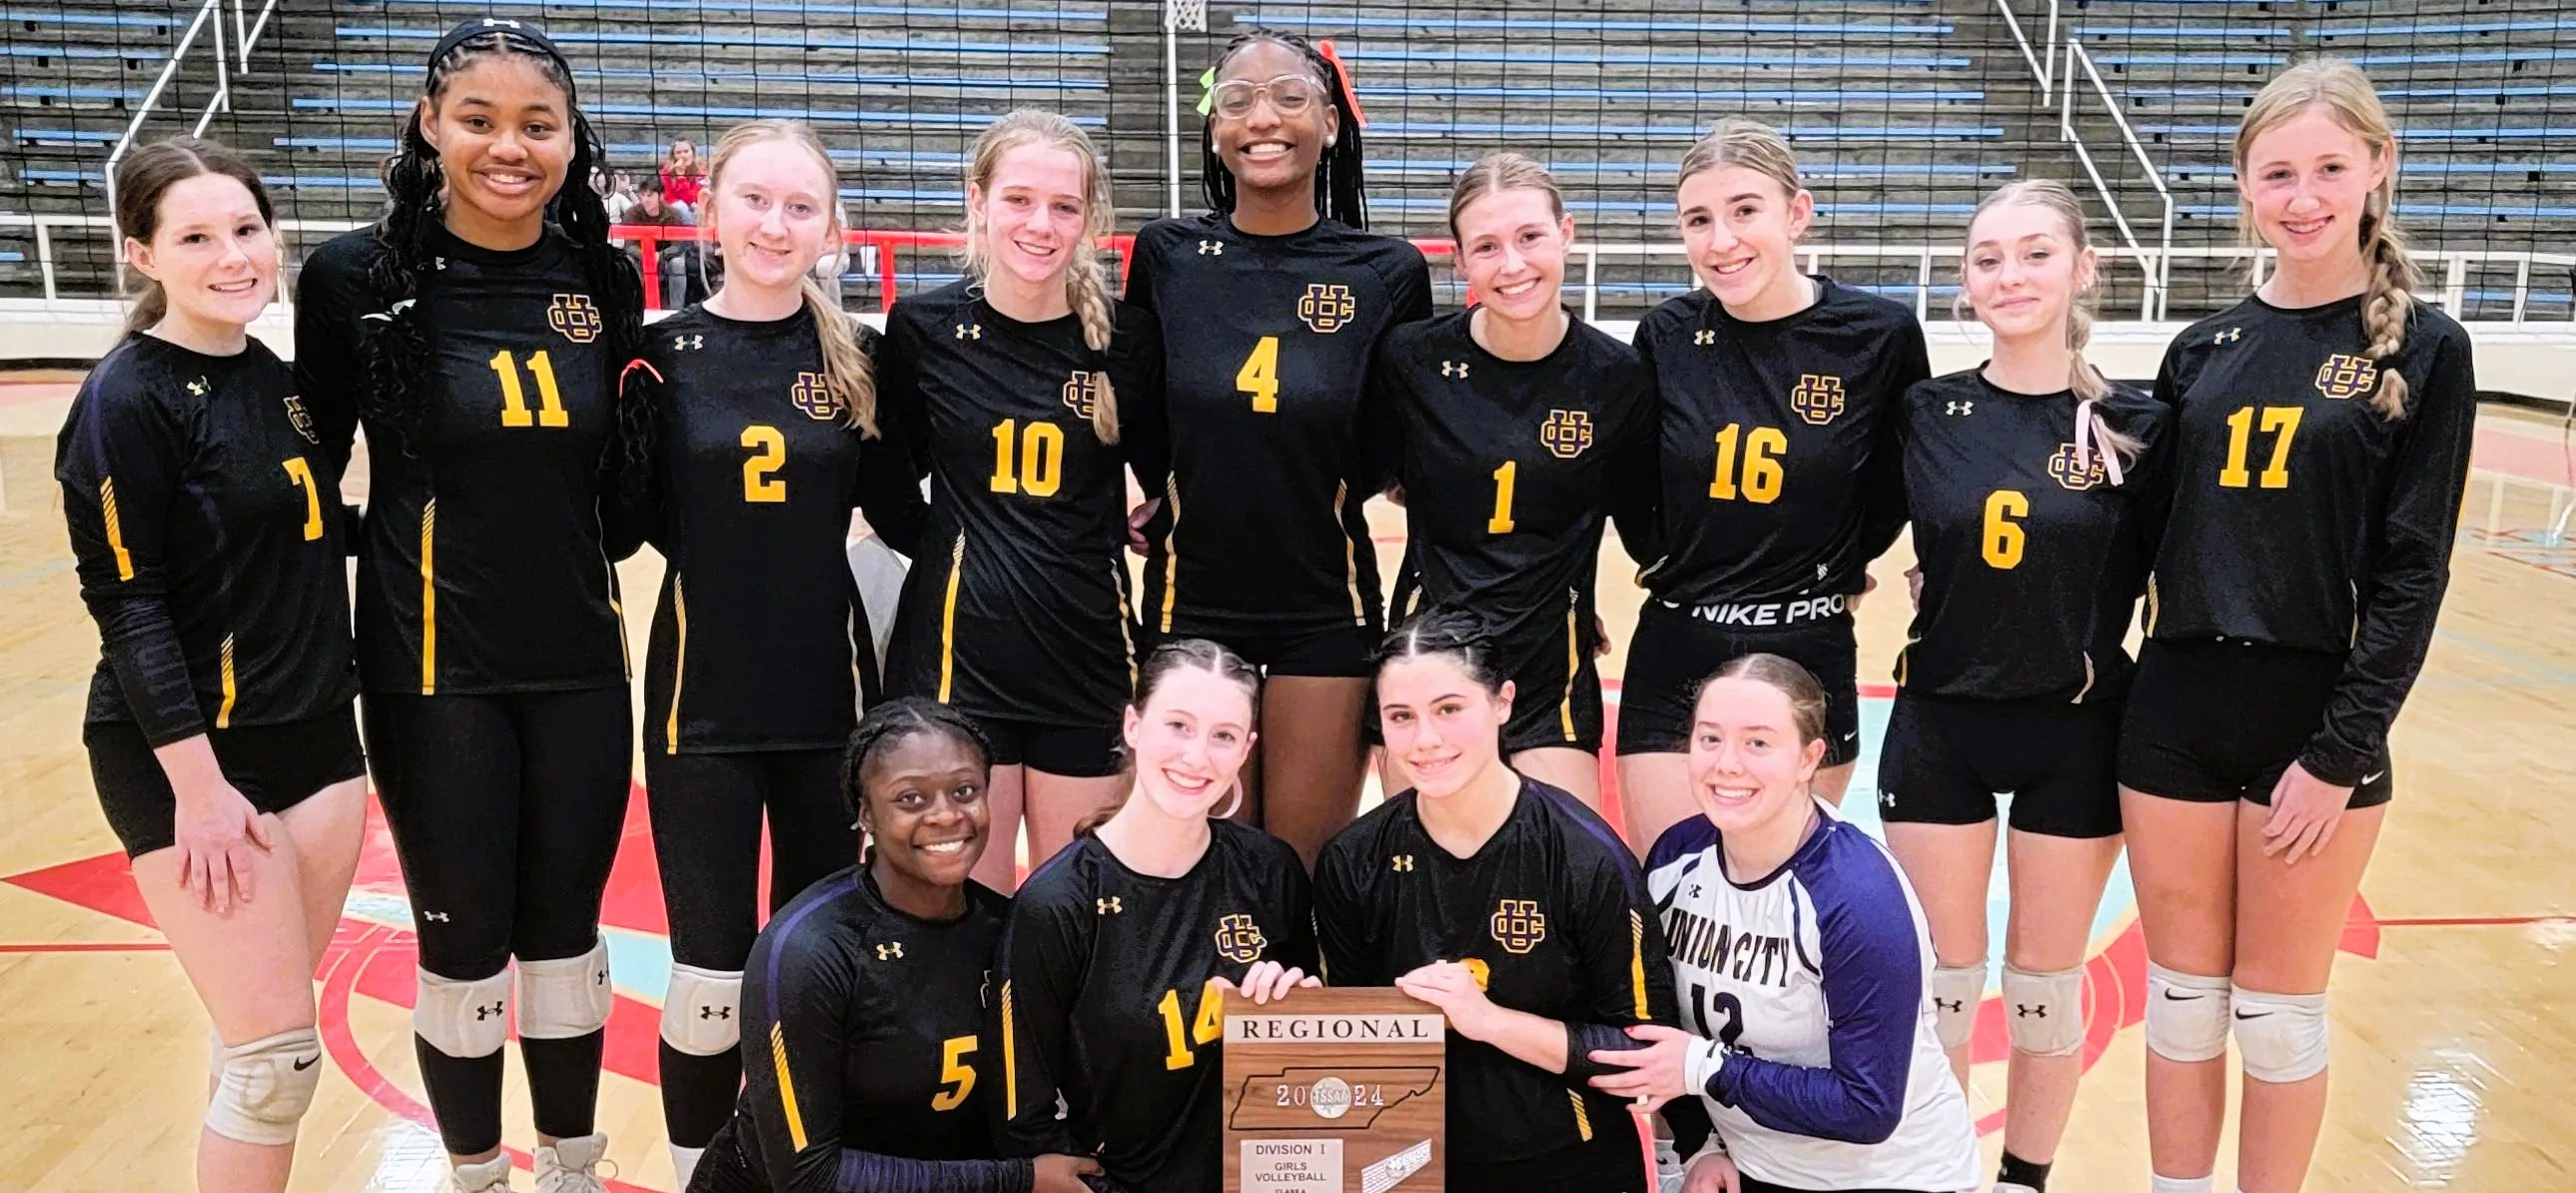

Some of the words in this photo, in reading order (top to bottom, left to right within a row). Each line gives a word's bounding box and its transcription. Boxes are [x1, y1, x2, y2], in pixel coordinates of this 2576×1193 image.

[489, 350, 569, 427] 11
[1236, 336, 1280, 414] 4
[740, 425, 787, 503] 2
[990, 419, 1065, 498] 10
[1709, 423, 1788, 505] 16
[2218, 406, 2304, 489] 17
[282, 456, 324, 542] 7
[1487, 461, 1516, 535] 1
[1981, 490, 2030, 570] 6
[1691, 602, 1782, 625] NIKE
[1785, 594, 1846, 624] PRO
[1732, 931, 1790, 988] CITY
[1158, 980, 1224, 1071] 14
[1242, 1019, 1429, 1039] REGIONAL
[1690, 982, 1754, 1057] 12
[931, 1034, 978, 1112] 5
[1277, 1084, 1307, 1107] 20
[1353, 1084, 1385, 1106] 24
[1256, 1144, 1312, 1155] DIVISION
[1320, 1144, 1325, 1155] I
[1256, 1172, 1326, 1182] VOLLEYBALL
[1275, 1162, 1307, 1171] GIRLS
